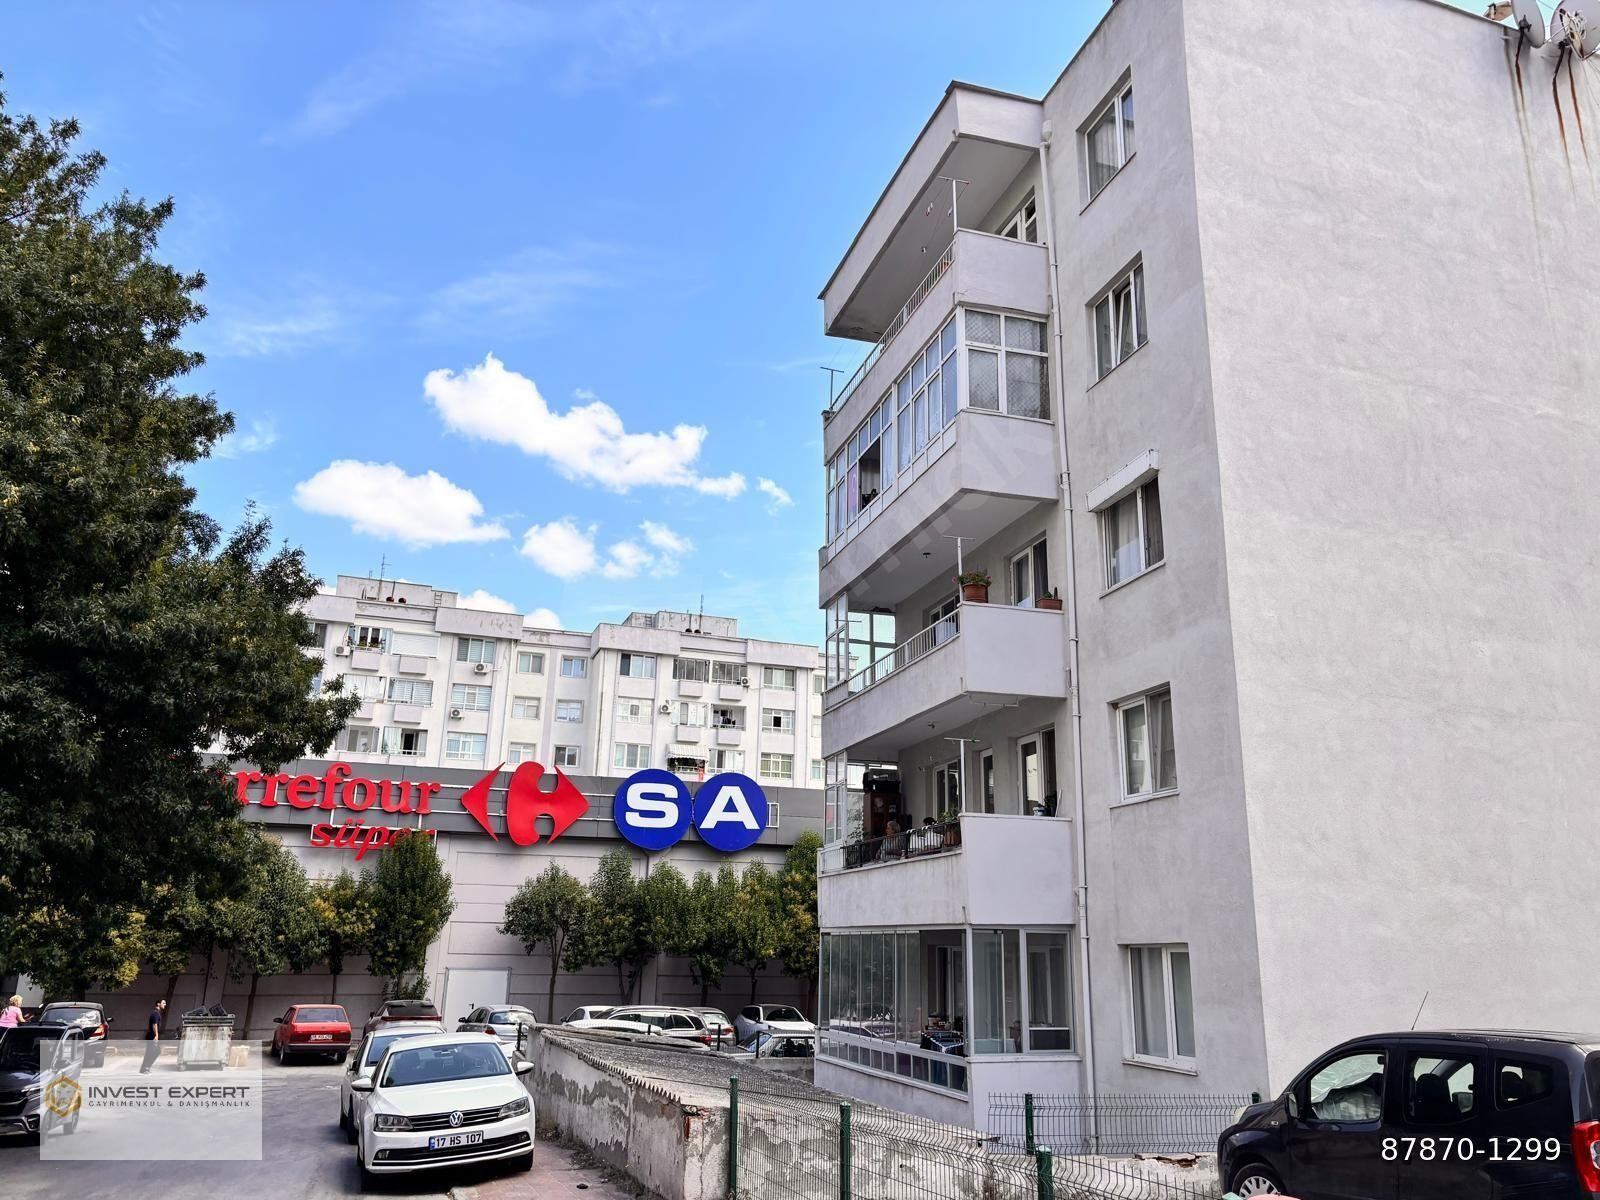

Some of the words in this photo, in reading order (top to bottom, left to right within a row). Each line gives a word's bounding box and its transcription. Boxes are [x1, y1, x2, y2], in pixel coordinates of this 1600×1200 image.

[436, 1137, 446, 1147] 17
[450, 1135, 461, 1146] HS
[466, 1133, 481, 1144] 107
